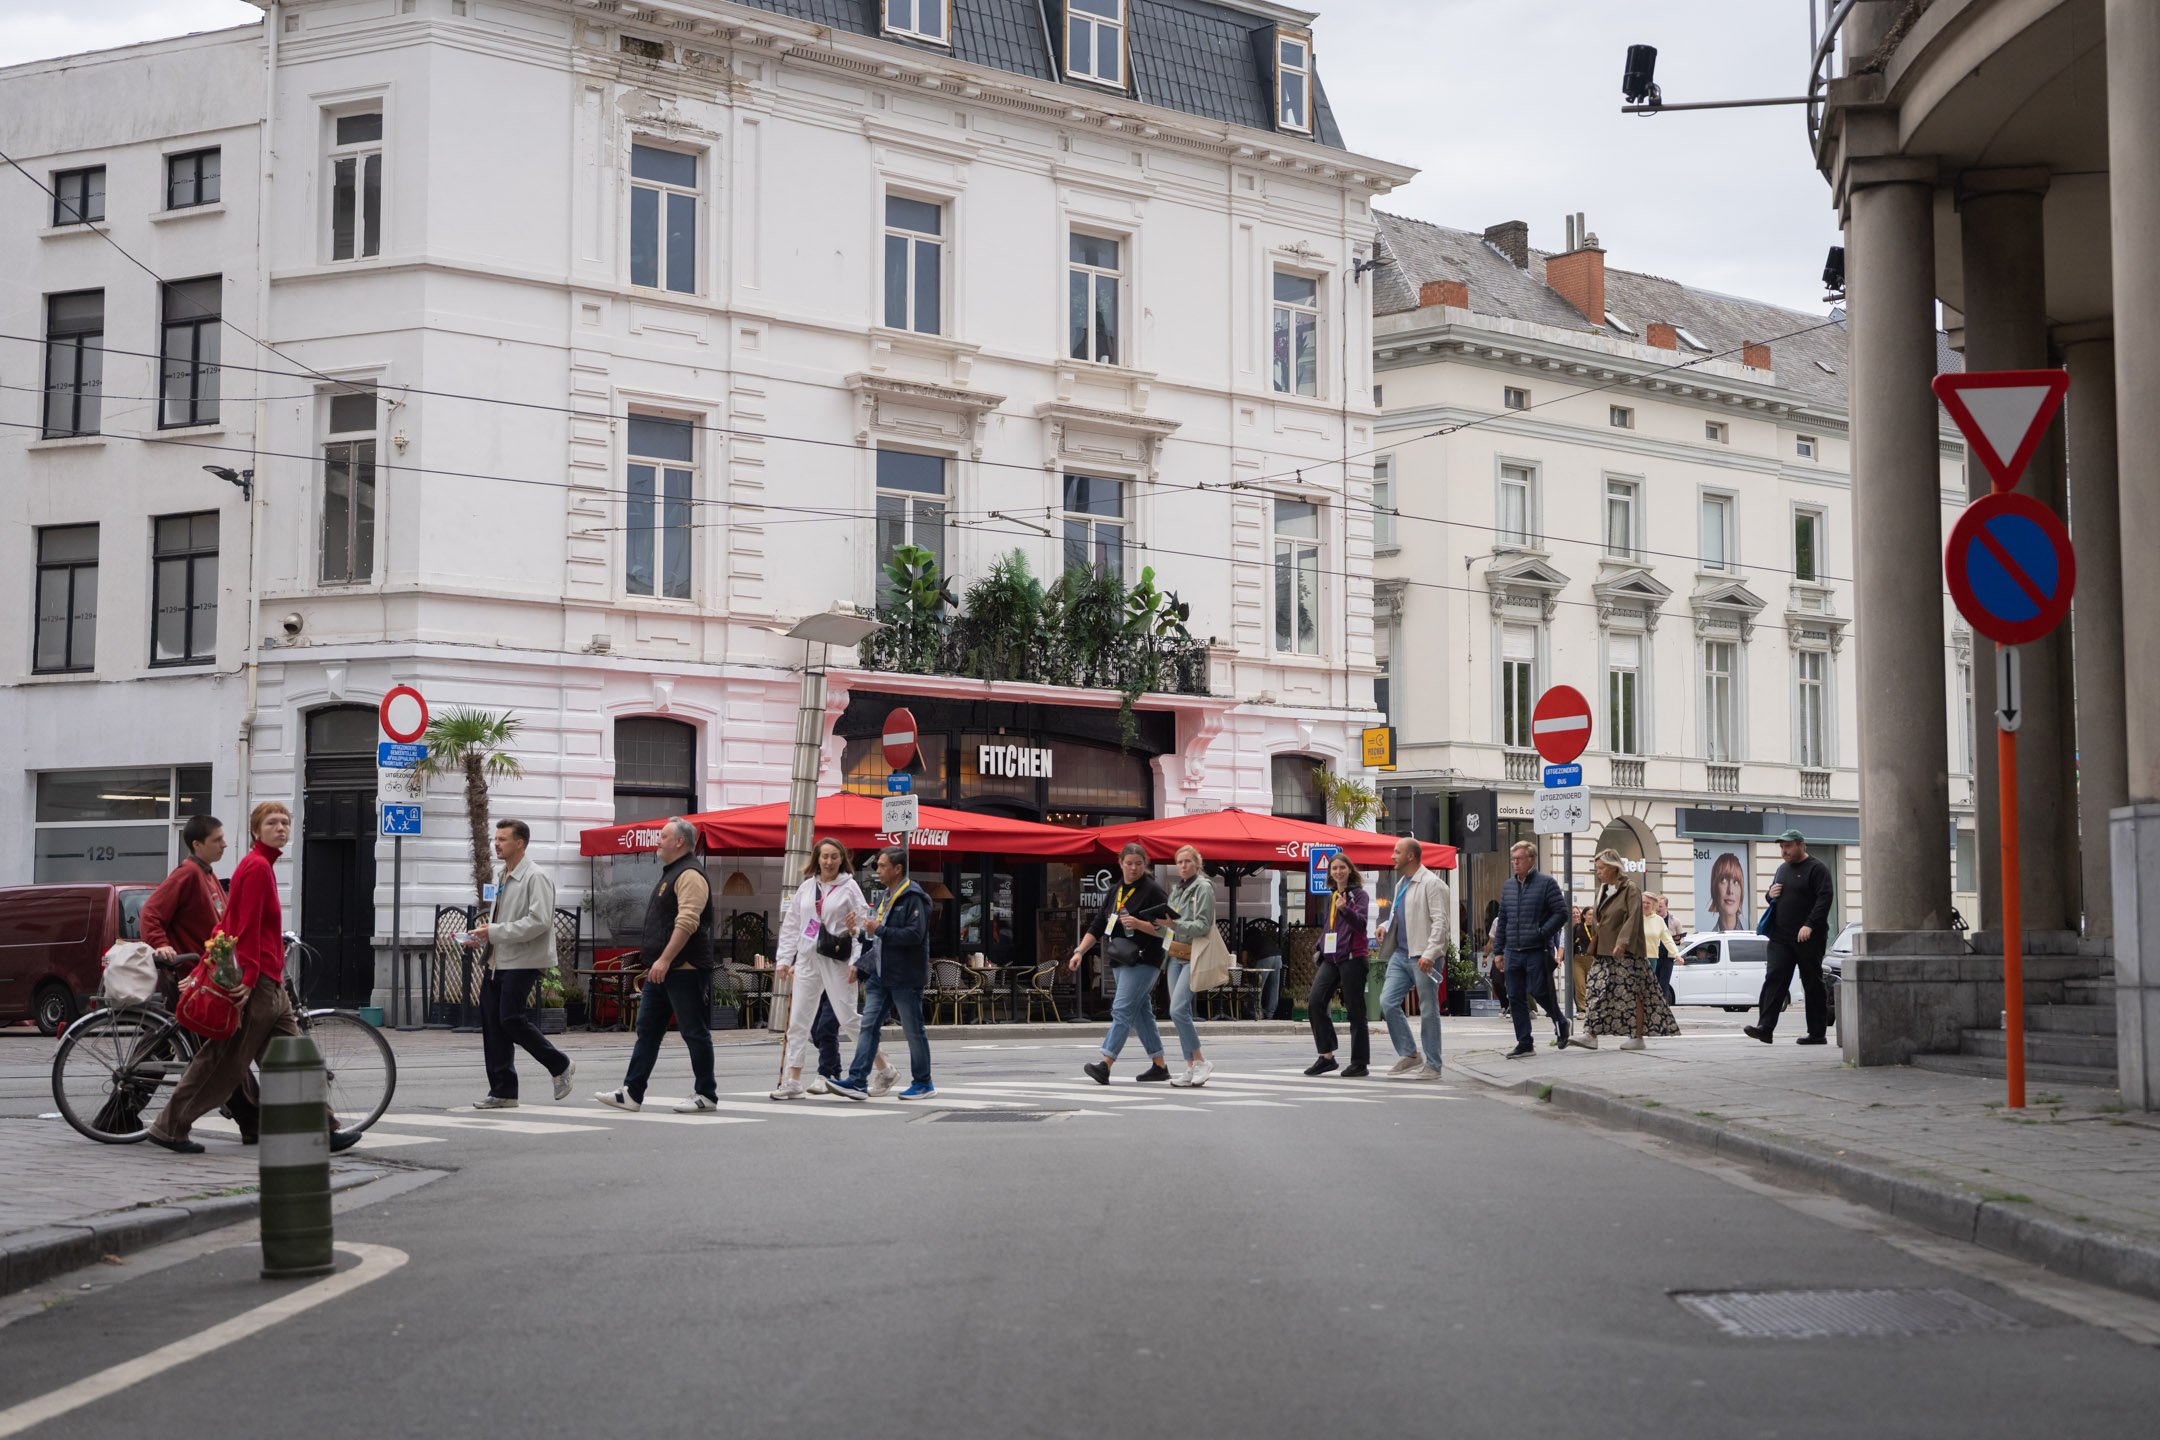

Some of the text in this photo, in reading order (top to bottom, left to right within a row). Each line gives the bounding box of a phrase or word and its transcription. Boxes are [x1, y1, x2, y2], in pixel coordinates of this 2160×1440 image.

[980, 745, 1053, 778] FITCHEN
[1545, 767, 1579, 775] UITGEZONDERD
[1541, 792, 1582, 801] UITGEZONDERD
[1499, 806, 1518, 815] colors
[1520, 807, 1524, 815] &
[86, 846, 115, 861] 129
